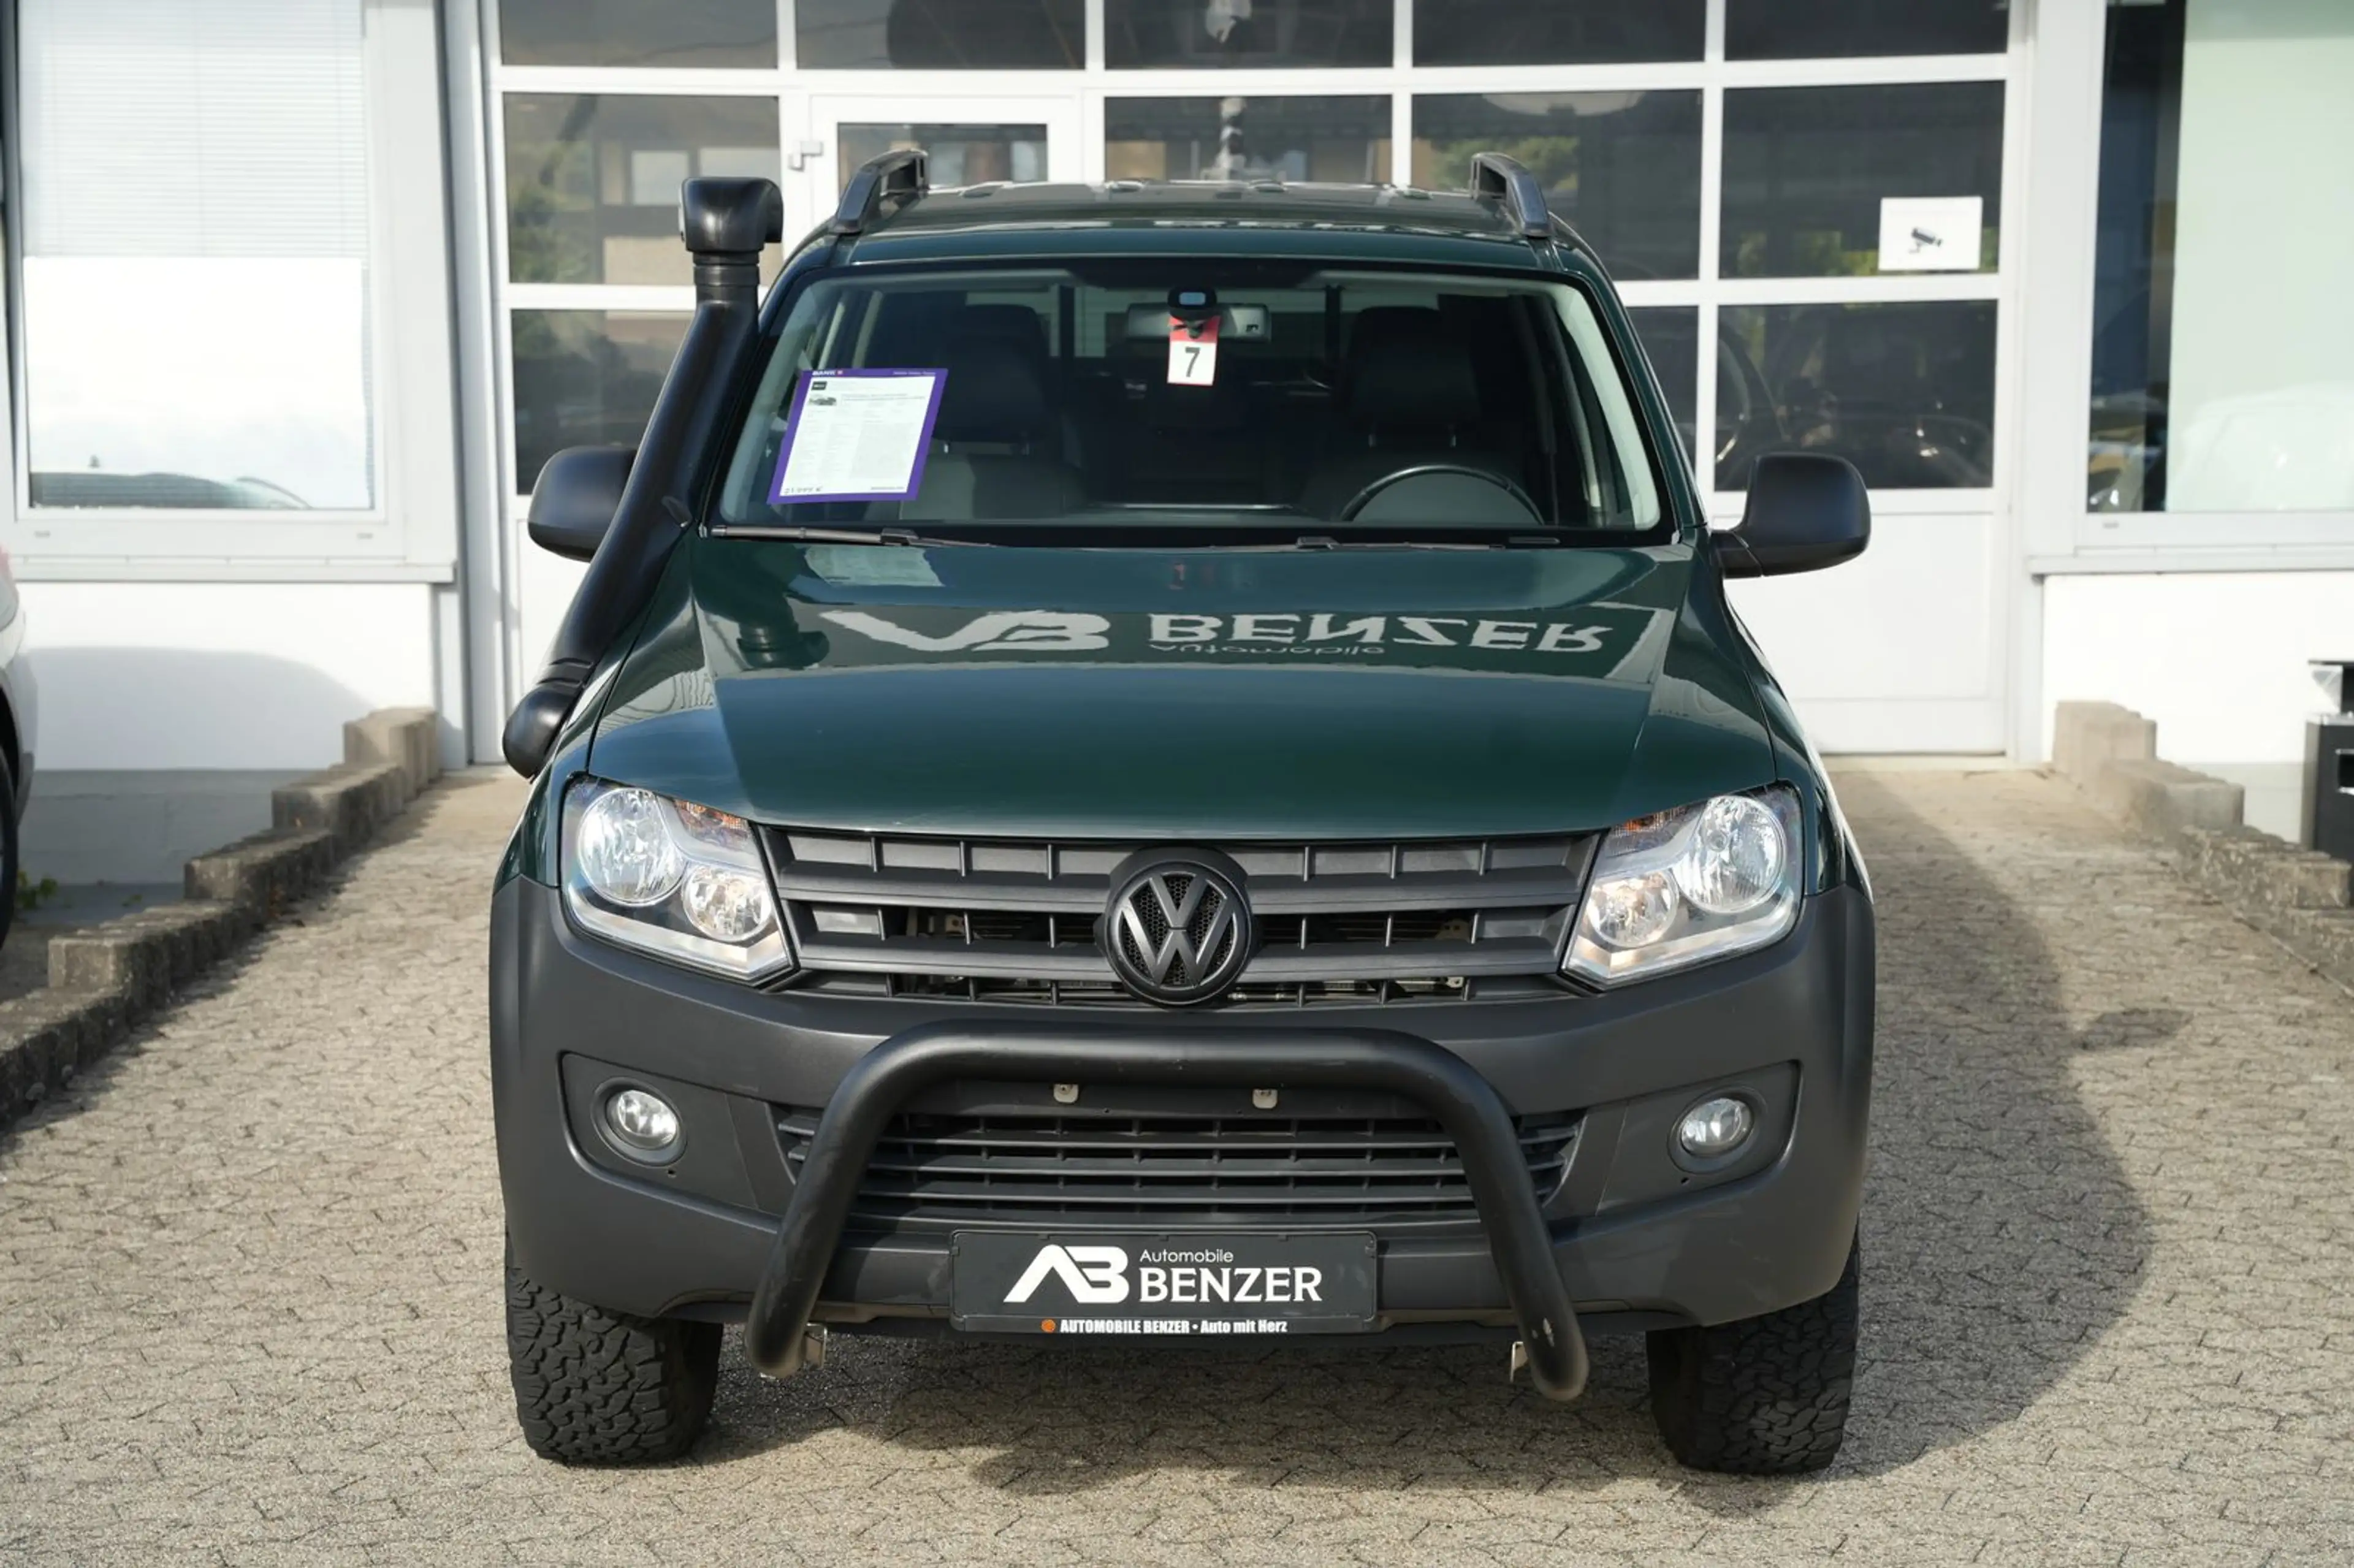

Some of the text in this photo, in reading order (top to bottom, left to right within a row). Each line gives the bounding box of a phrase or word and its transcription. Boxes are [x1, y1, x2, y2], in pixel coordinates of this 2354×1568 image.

[1185, 346, 1201, 378] 7
[1140, 1249, 1234, 1263] Automobile
[1003, 1244, 1130, 1303] AB
[1139, 1266, 1322, 1303] BENZER
[1059, 1319, 1288, 1334] AUTOMOBILE BENZER Auto mit Herz
